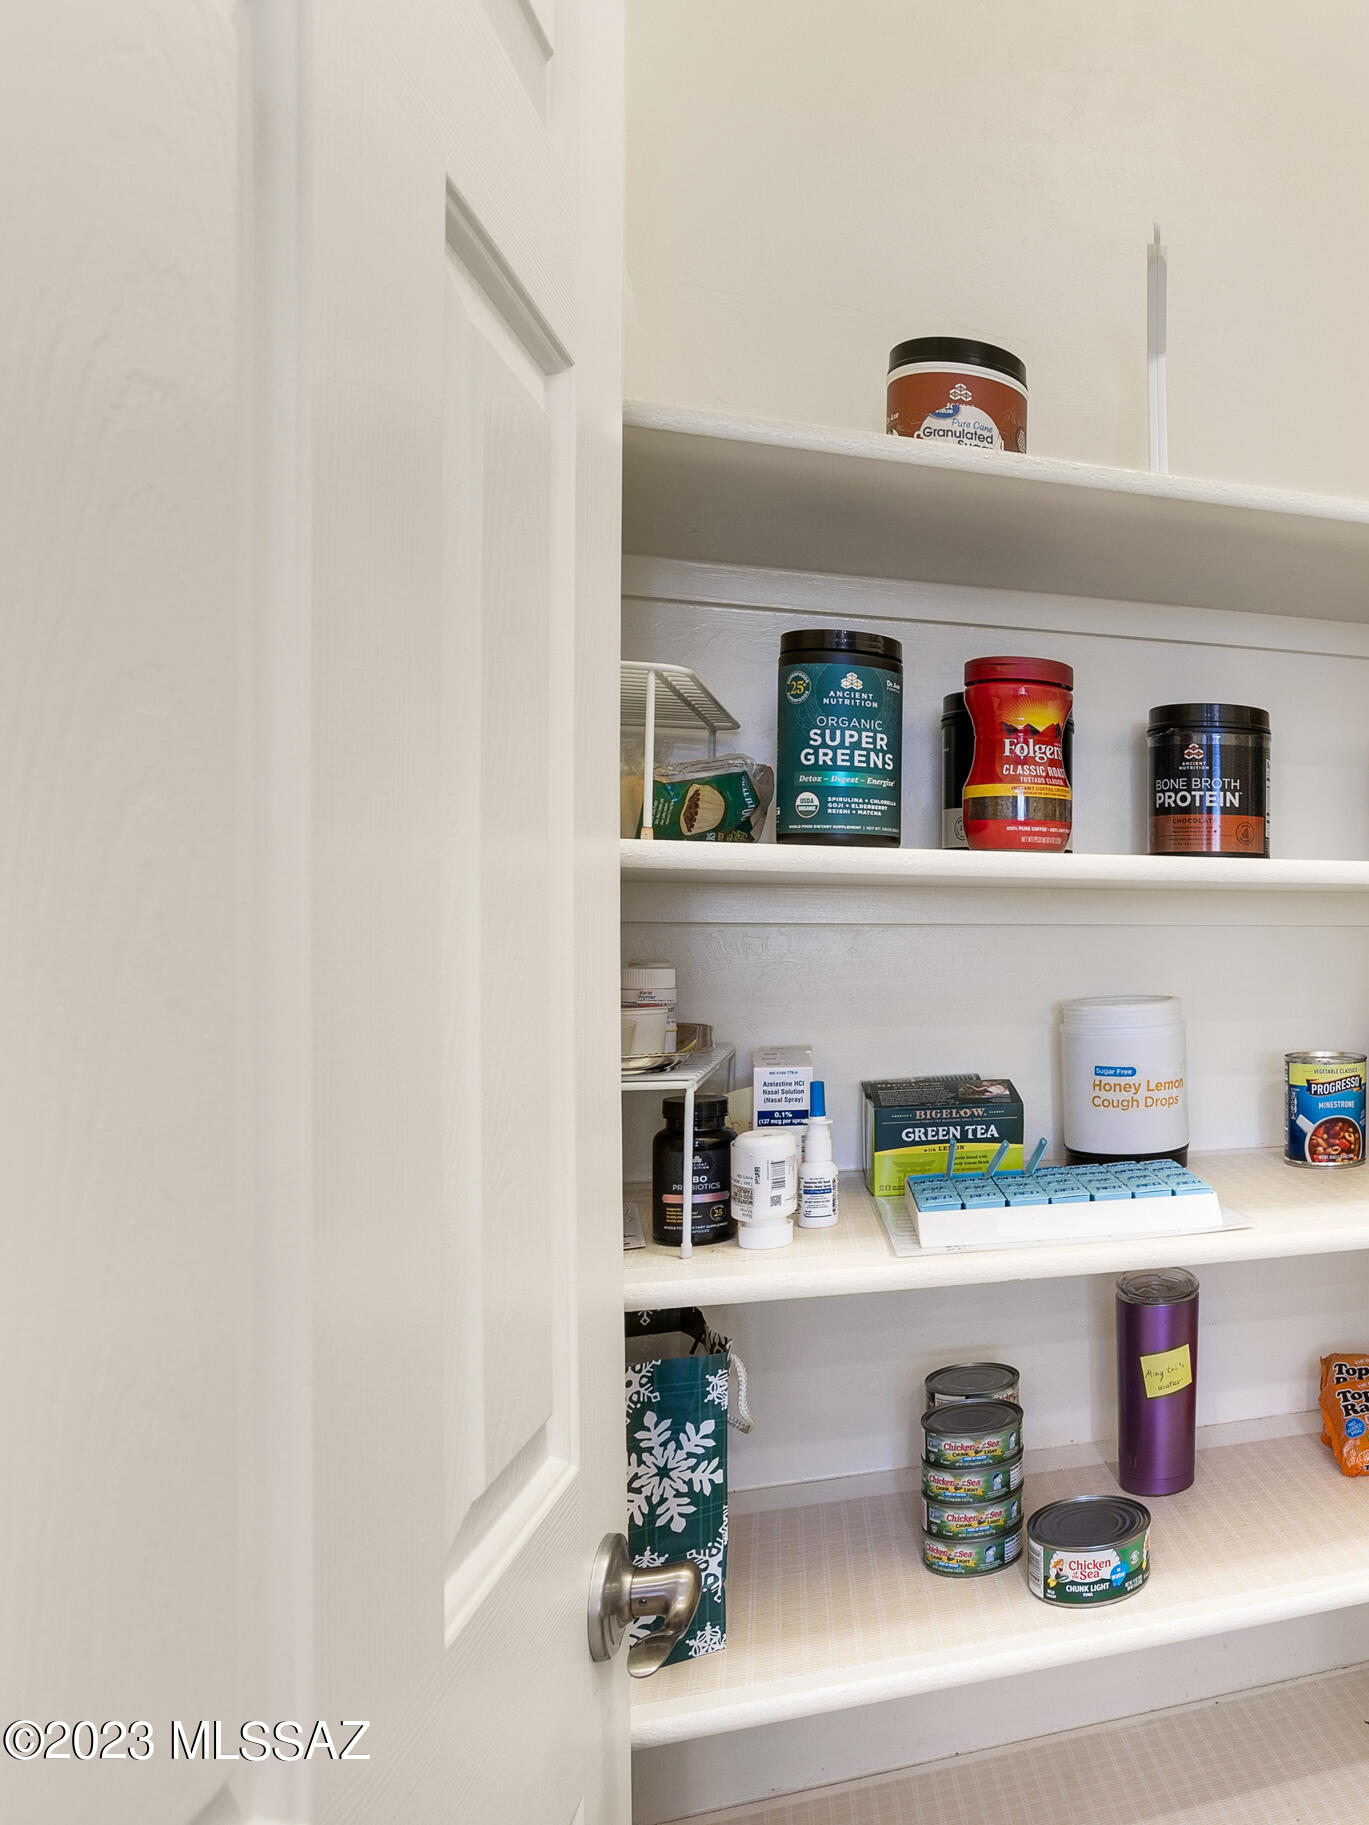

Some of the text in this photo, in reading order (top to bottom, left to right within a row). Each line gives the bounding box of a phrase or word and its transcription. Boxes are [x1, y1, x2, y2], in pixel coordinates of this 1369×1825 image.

[952, 417, 993, 433] Pure Cane
[922, 426, 994, 446] Granulated
[828, 690, 873, 700] ANCIENT
[823, 698, 878, 708] NUTRITION
[816, 715, 883, 731] ORGANIC
[809, 728, 888, 750] SUPER
[1002, 738, 1062, 763] Folgers
[800, 747, 894, 770] GREENS
[1002, 764, 1046, 776] CLASSIC
[1155, 777, 1240, 791] BONE BROTH
[1155, 791, 1240, 808] PROTEIN
[1095, 1067, 1133, 1075] Sugar Free
[1092, 1078, 1184, 1095] Honey Lemon
[1310, 1076, 1360, 1095] PROGRESSO
[1091, 1095, 1179, 1111] Cough Drops
[1318, 1100, 1355, 1109] MINESTRONE
[915, 1107, 986, 1120] BIGELOW
[901, 1124, 999, 1142] GREEN TEA
[672, 1182, 720, 1191] PRBIOTICS
[1333, 1363, 1369, 1380] Top
[943, 1442, 975, 1452] Chicken
[929, 1474, 955, 1486] Chicken
[946, 1510, 1003, 1523] Chicken Sea
[925, 1542, 948, 1556] Chicken
[1068, 1559, 1112, 1571] Chicken
[1079, 1570, 1100, 1581] Sea
[1065, 1582, 1110, 1593] CHUNK LIGHT
